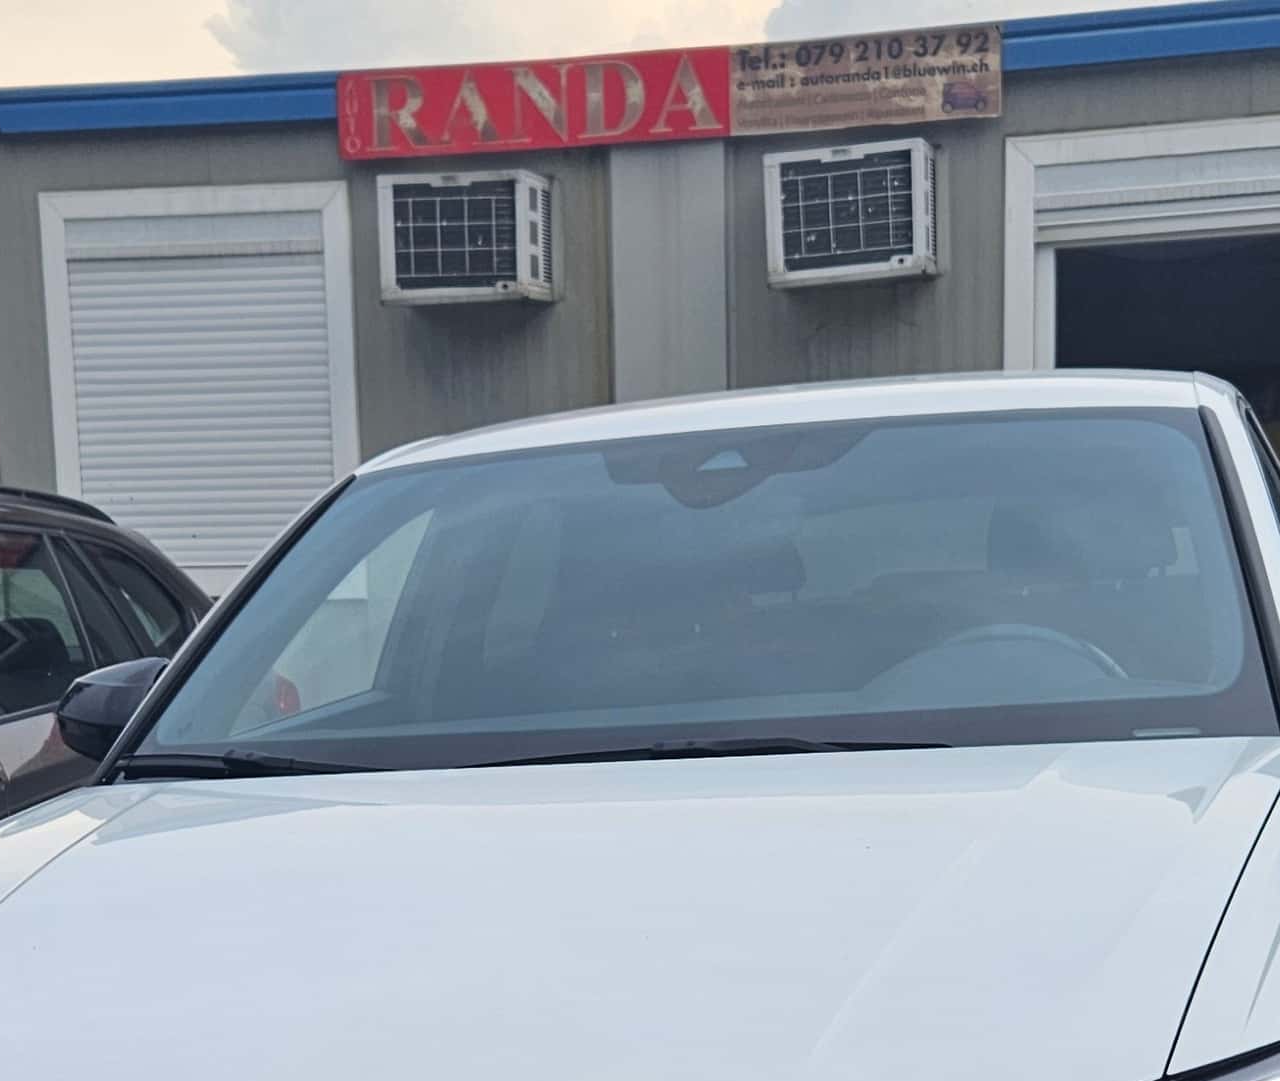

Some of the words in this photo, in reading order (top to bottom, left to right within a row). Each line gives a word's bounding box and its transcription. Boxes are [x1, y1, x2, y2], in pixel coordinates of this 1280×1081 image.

[736, 48, 786, 73] Tel.:
[795, 42, 845, 68] 079
[854, 38, 904, 63] 210
[912, 34, 946, 59] 37
[956, 32, 990, 55] 92
[365, 53, 723, 152] RANDA
[736, 74, 785, 91] e-mail
[344, 79, 361, 154] AUTO
